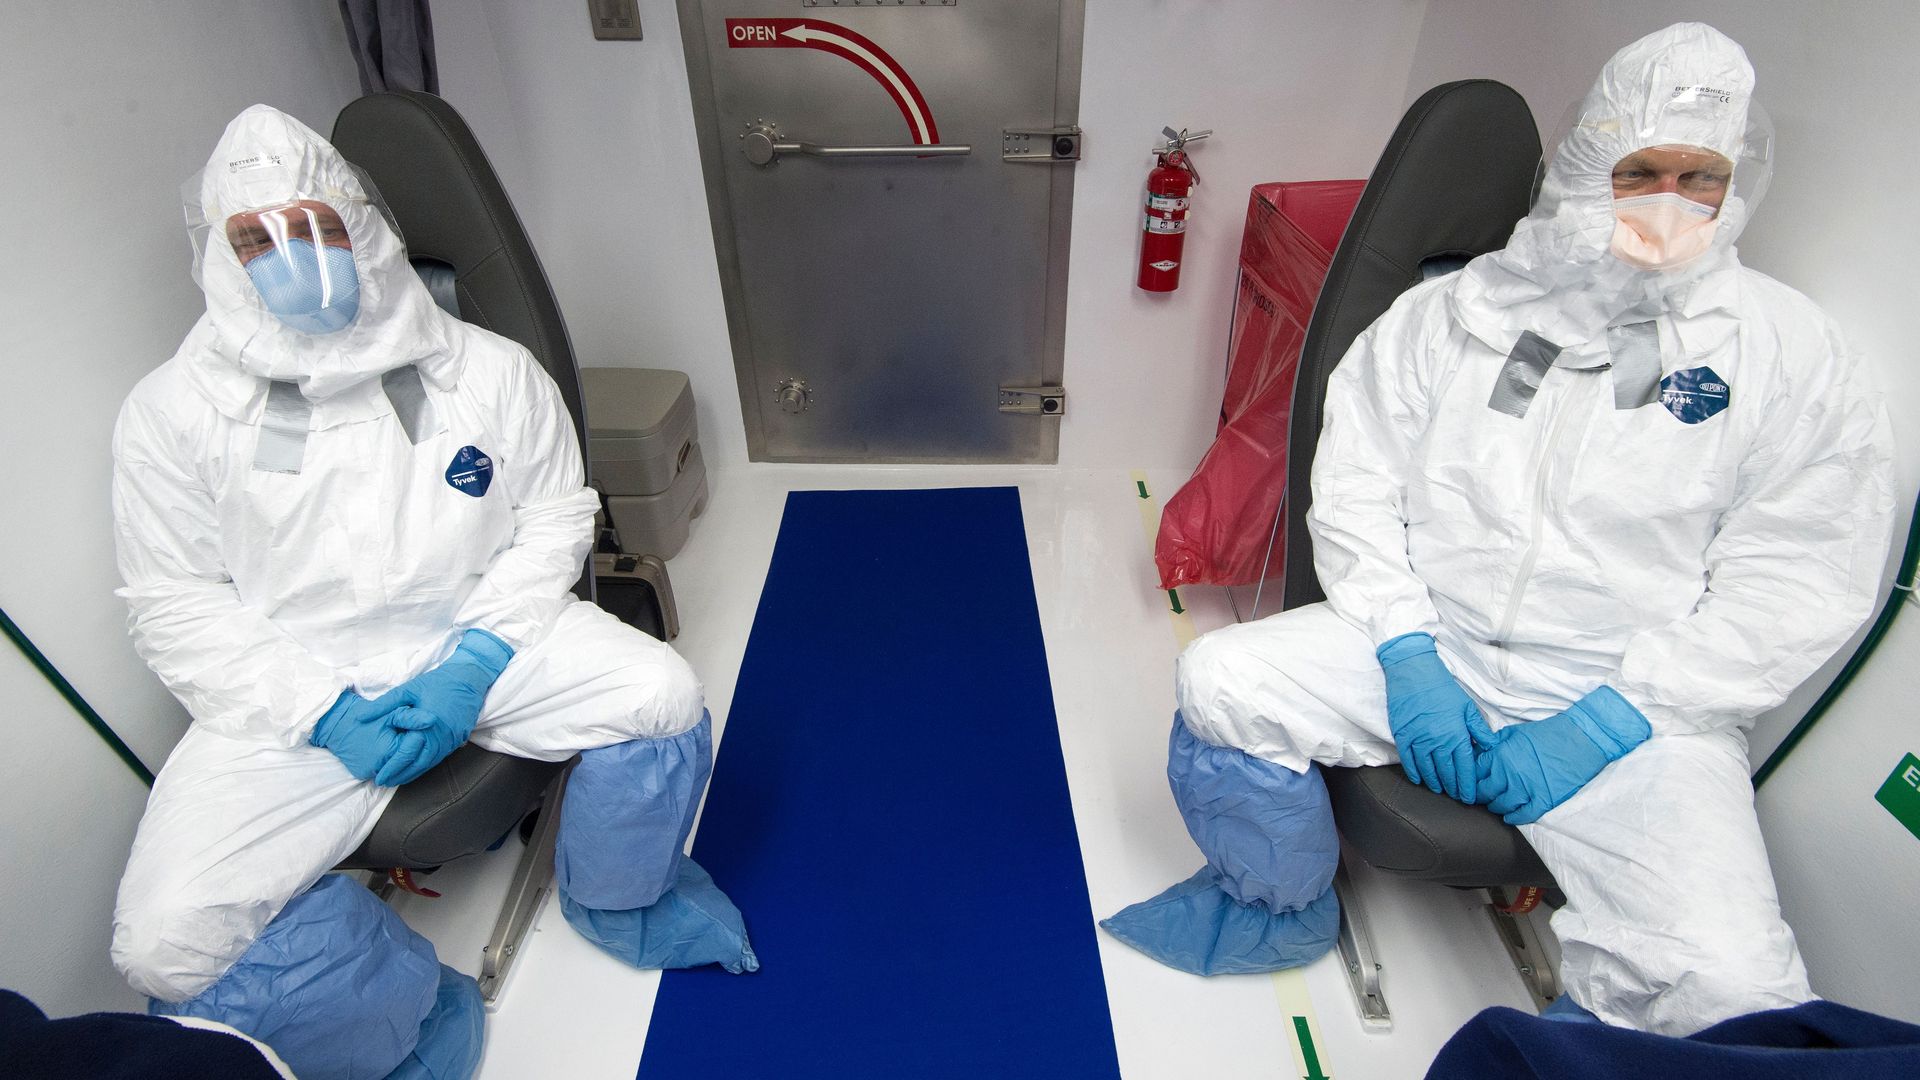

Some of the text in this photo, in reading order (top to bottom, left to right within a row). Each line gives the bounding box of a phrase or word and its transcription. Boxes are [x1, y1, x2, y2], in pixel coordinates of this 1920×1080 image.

[732, 25, 777, 41] OPEN
[1674, 86, 1731, 96] BETERSHIELD
[1662, 394, 1692, 405] Tyvek
[452, 475, 476, 487] Tyvek
